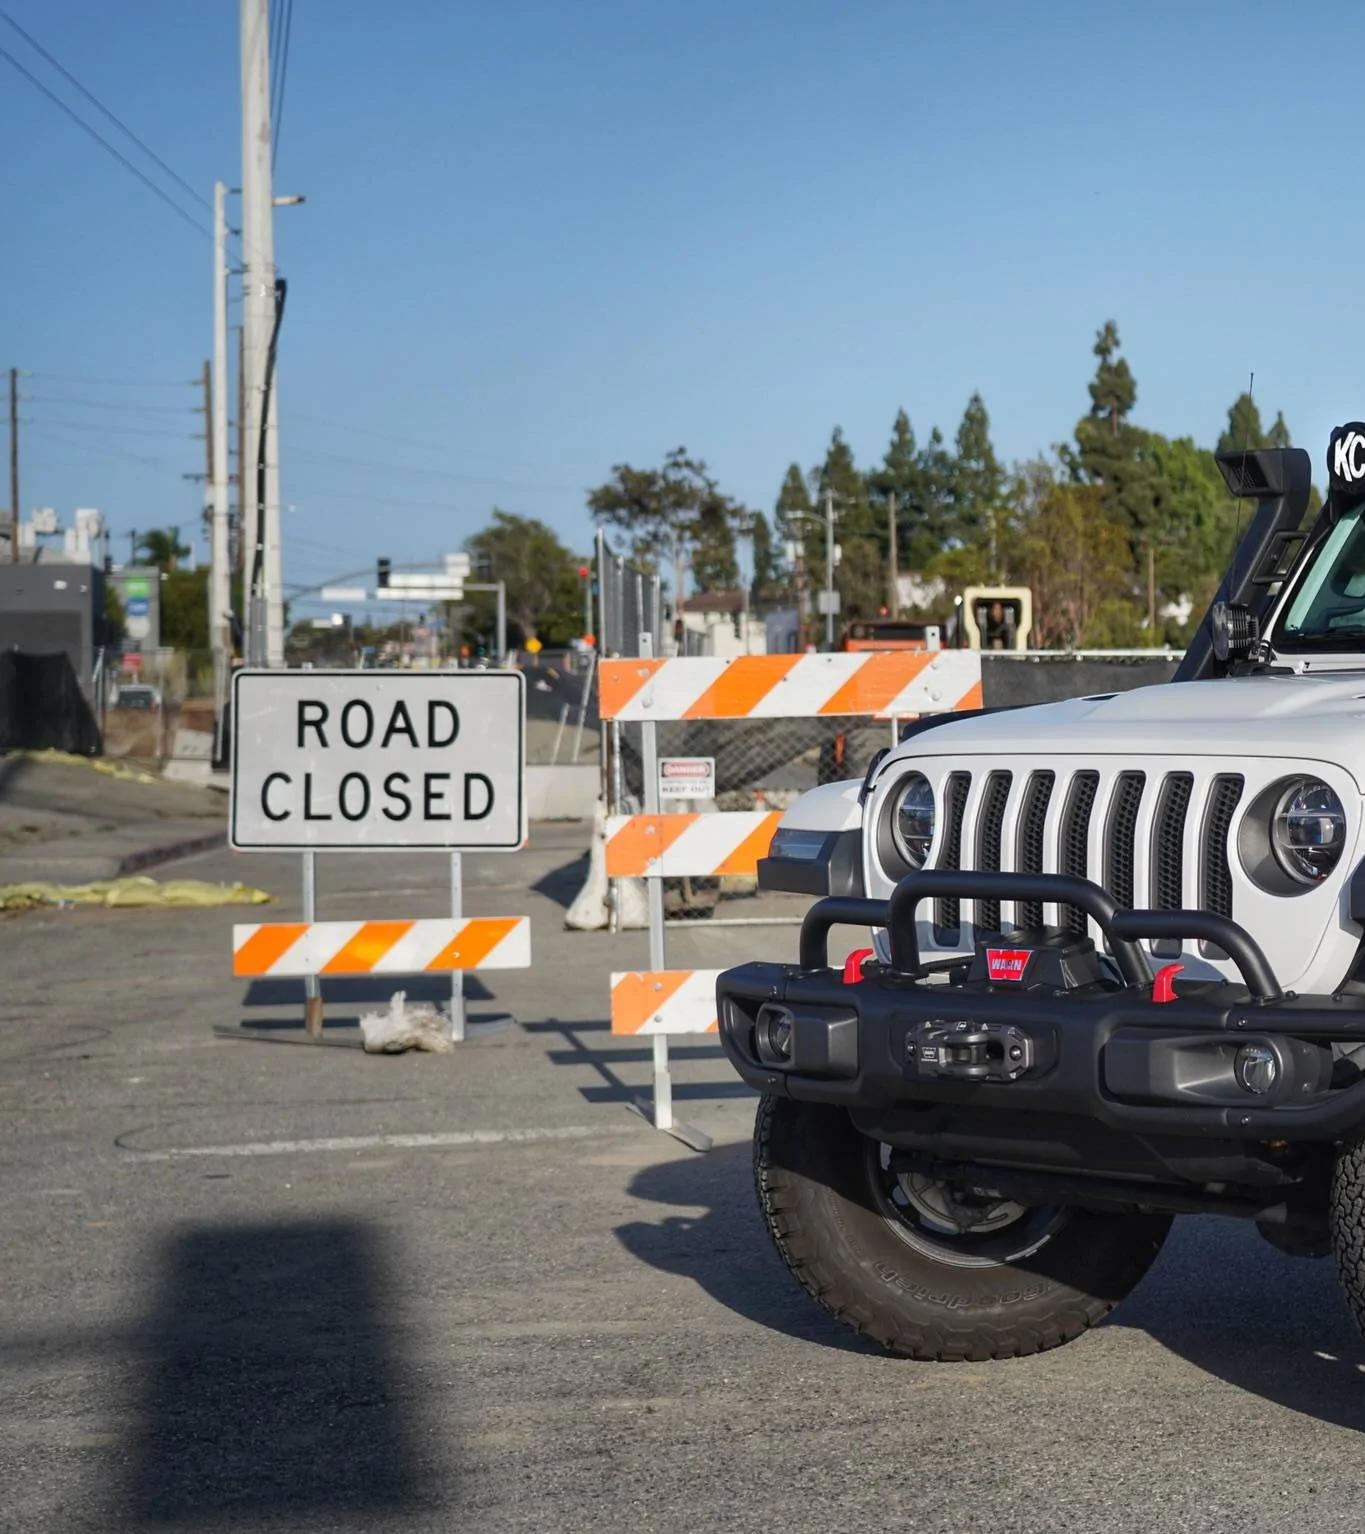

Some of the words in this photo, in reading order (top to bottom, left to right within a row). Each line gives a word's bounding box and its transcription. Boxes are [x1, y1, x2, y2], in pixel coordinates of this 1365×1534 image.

[297, 699, 460, 749] ROAD
[261, 772, 495, 821] CLOSED
[992, 958, 1022, 971] WARN
